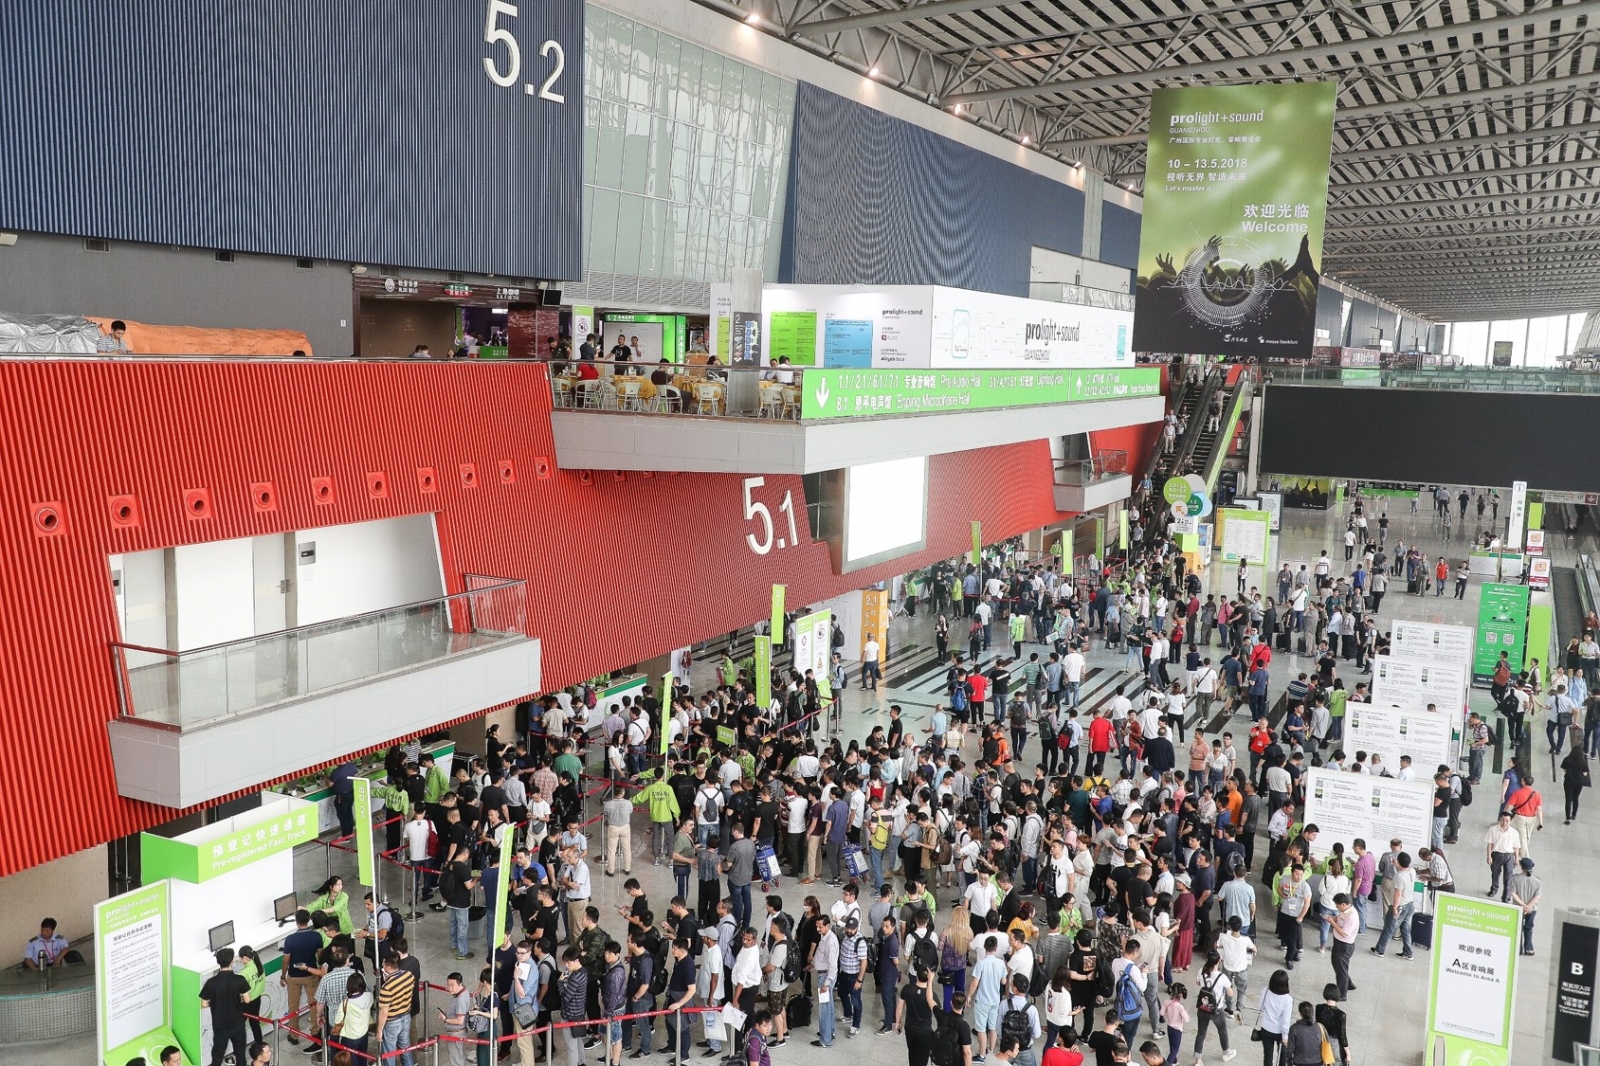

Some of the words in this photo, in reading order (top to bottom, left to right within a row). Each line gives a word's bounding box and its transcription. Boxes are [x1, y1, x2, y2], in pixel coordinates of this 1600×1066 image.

[483, 0, 565, 104] 5.2
[1170, 110, 1264, 126] prolight+sound
[1168, 159, 1181, 169] 10
[1194, 158, 1248, 169] 13.5.2018
[1166, 172, 1204, 182] 视听无界
[1243, 204, 1310, 218] 欢迎光临
[1241, 220, 1308, 233] Welcome
[882, 308, 923, 316] prolight+sound
[1025, 318, 1080, 346] prolight+sound
[1024, 349, 1050, 361] GUANGZHOU
[904, 373, 936, 389] 专业音响馆
[940, 375, 951, 388] Pro
[952, 374, 969, 388] Audio
[971, 374, 982, 388] Hall
[836, 396, 848, 411] 8.1
[897, 393, 920, 411] Enping
[922, 391, 957, 410] Microphone
[958, 391, 970, 406] Hall
[742, 476, 798, 555] 5.1
[866, 594, 877, 603] 5.1
[213, 813, 306, 858] 预登记快速通道
[213, 843, 267, 870] Pre-registered
[269, 837, 285, 848] Fast
[287, 828, 307, 841] Track
[106, 892, 159, 920] prolight+sound
[1446, 904, 1510, 922] prolight+sound
[1458, 944, 1492, 957] 欢迎参观
[1445, 967, 1472, 977] Welcome
[1480, 974, 1494, 982] Area
[1571, 962, 1584, 975] B
